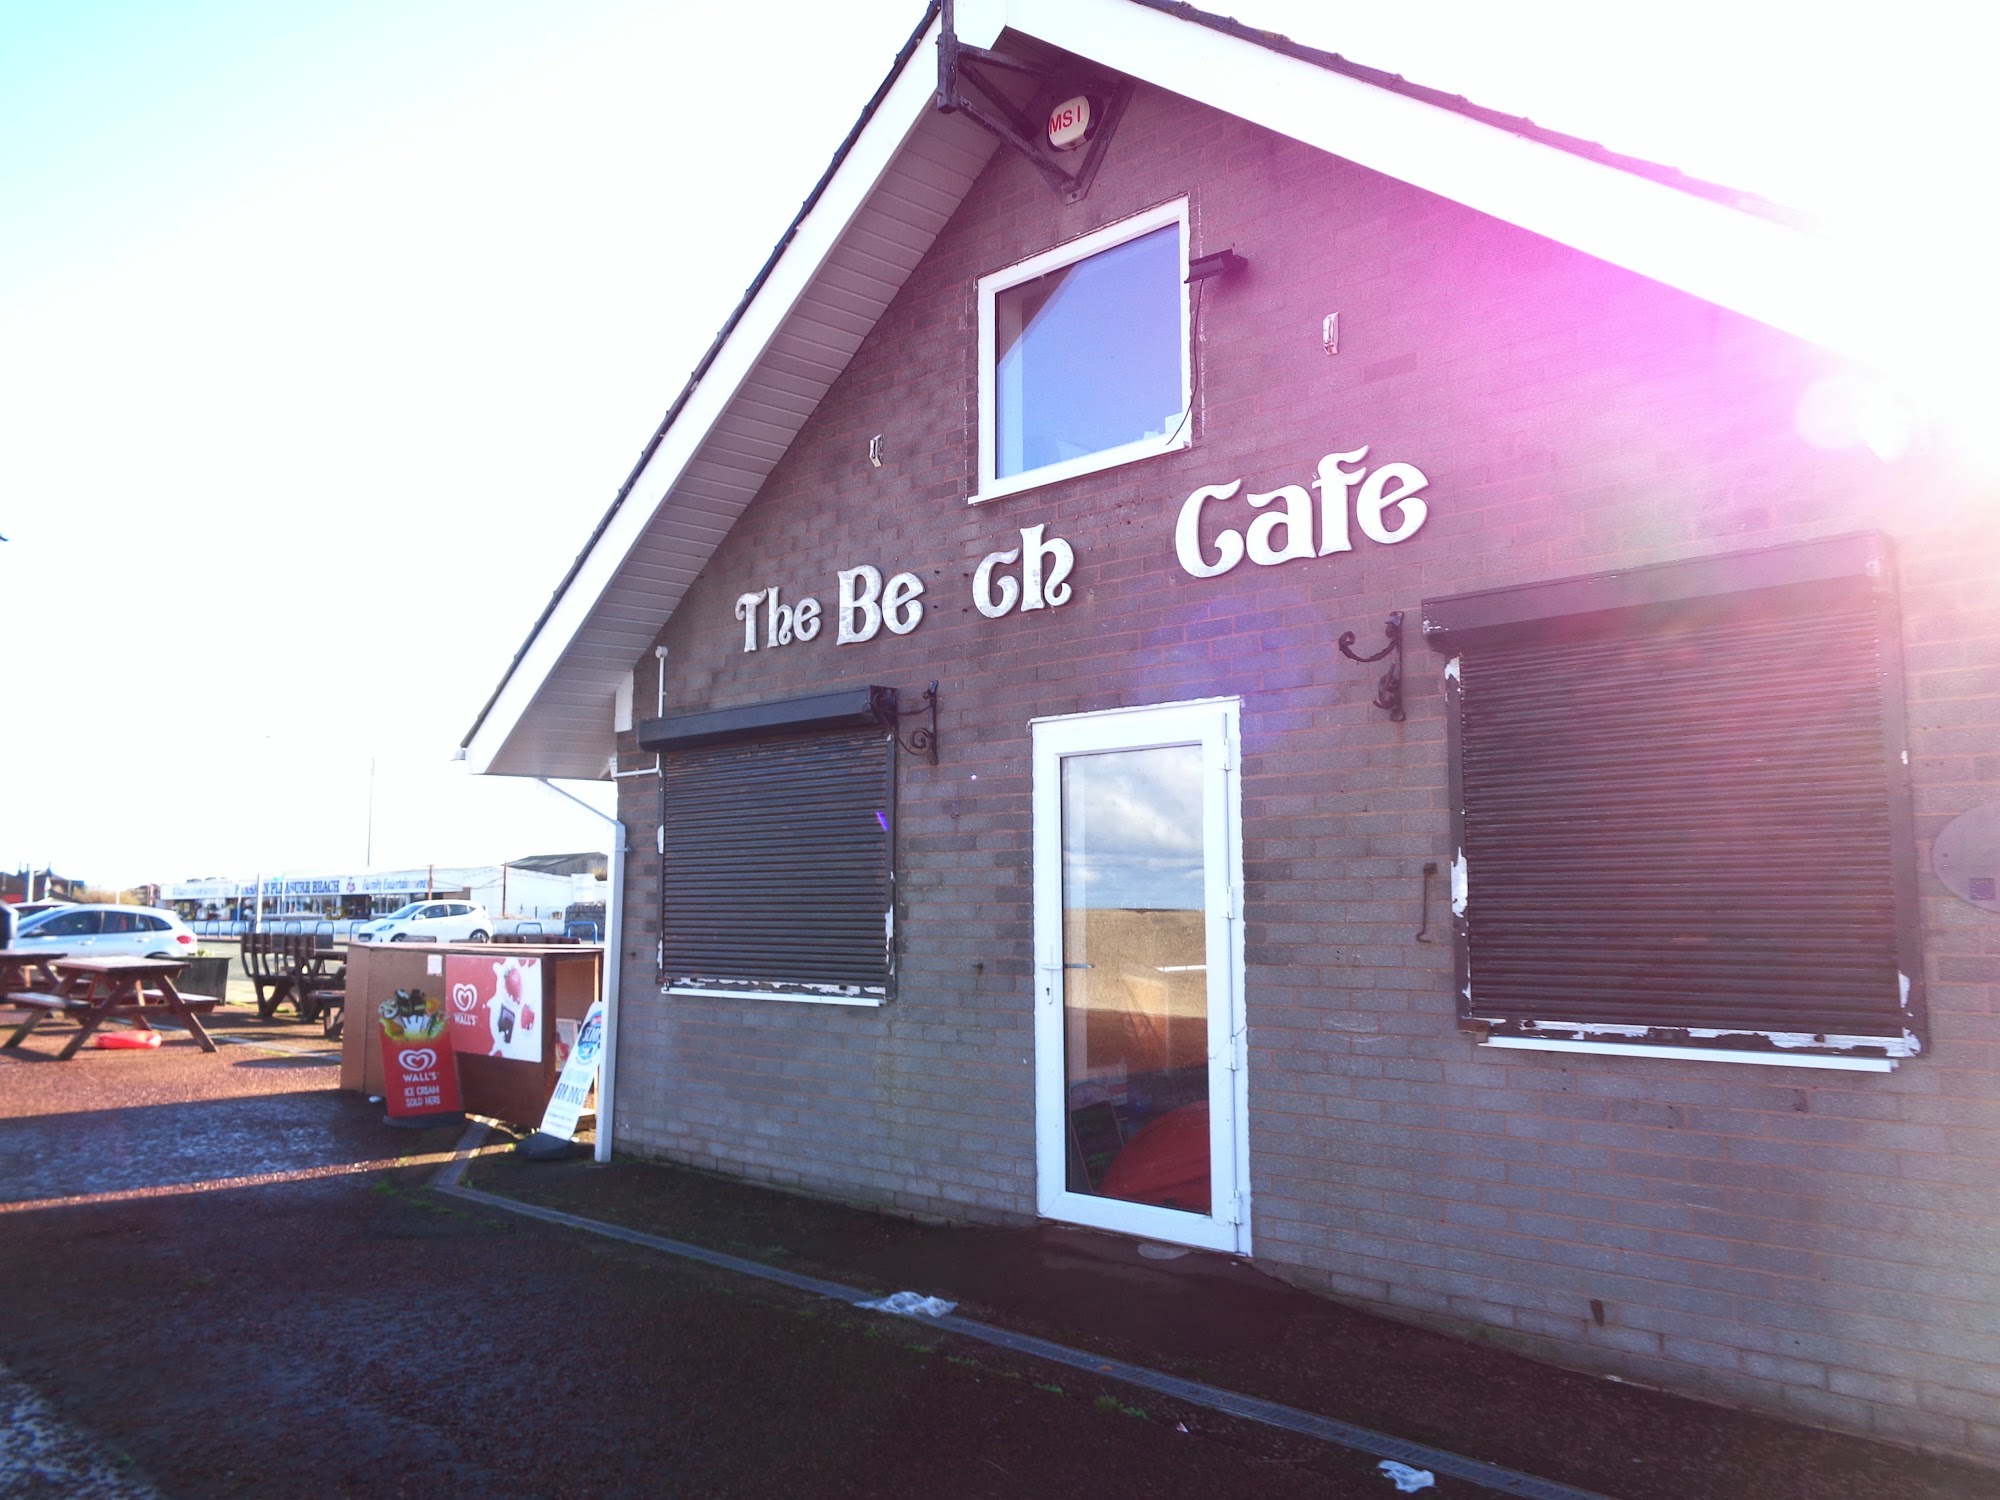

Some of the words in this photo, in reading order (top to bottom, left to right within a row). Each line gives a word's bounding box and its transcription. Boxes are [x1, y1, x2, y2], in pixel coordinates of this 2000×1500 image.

[735, 587, 821, 652] The
[1174, 444, 1430, 579] Cafe
[312, 880, 340, 893] BEACH
[454, 1013, 477, 1026] WALL'S
[403, 1072, 437, 1082] WALL'S
[416, 1086, 439, 1096] CREAM
